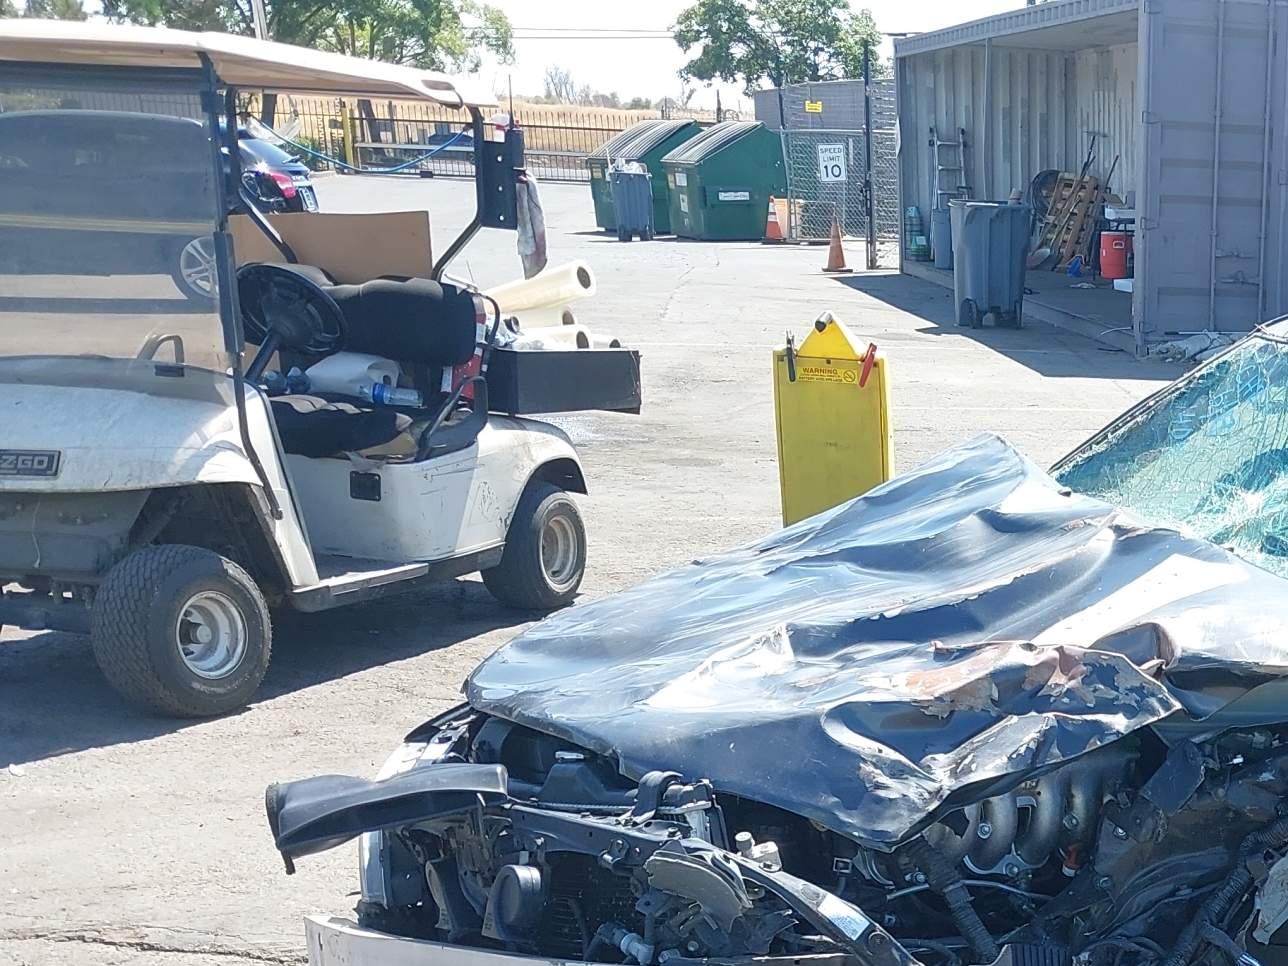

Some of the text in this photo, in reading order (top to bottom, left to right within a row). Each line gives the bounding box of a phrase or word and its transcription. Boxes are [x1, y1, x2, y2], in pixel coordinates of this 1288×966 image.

[823, 164, 842, 178] 10
[802, 367, 838, 375] WARNING
[0, 455, 49, 469] ZGO
